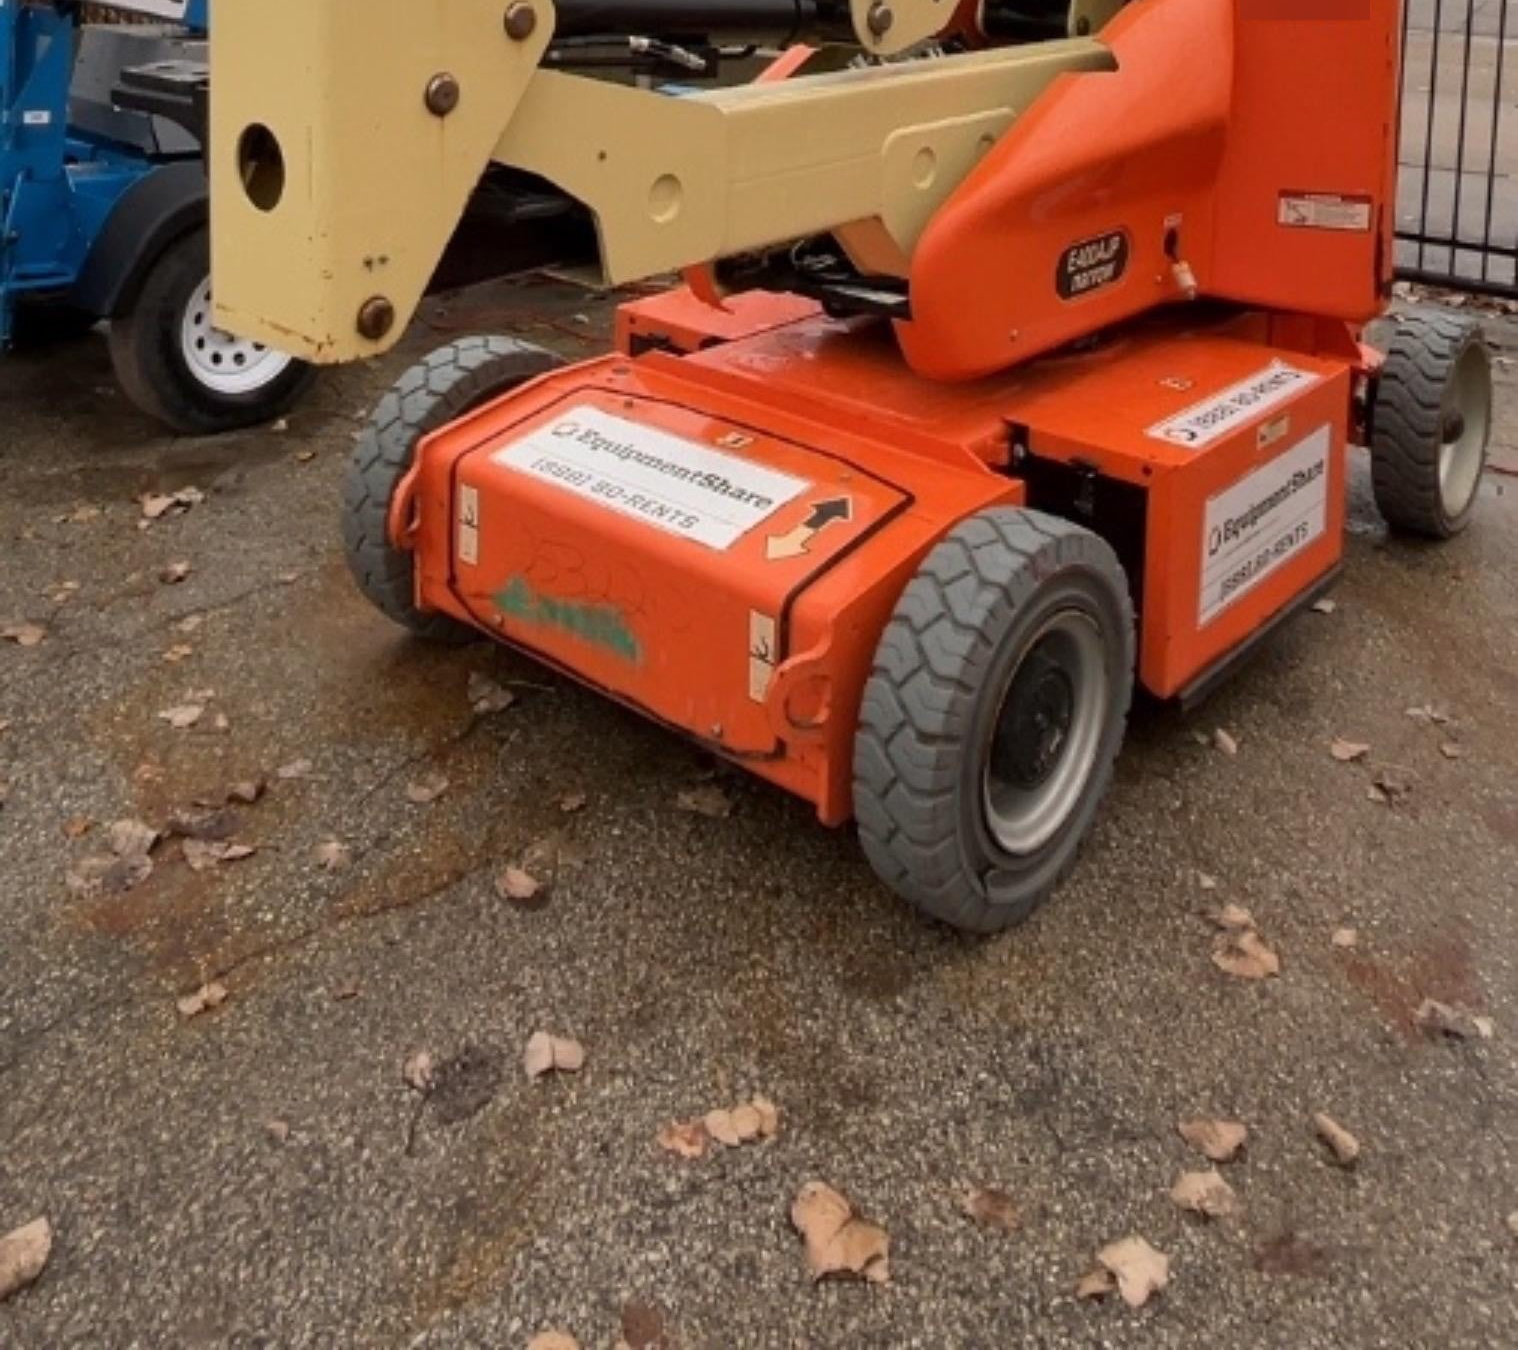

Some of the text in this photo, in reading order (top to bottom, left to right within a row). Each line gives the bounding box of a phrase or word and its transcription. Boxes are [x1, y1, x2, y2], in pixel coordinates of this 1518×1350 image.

[576, 427, 774, 511] EquipmentShare
[591, 478, 701, 530] 80-RENTS
[1223, 459, 1324, 543] EquipmentShare
